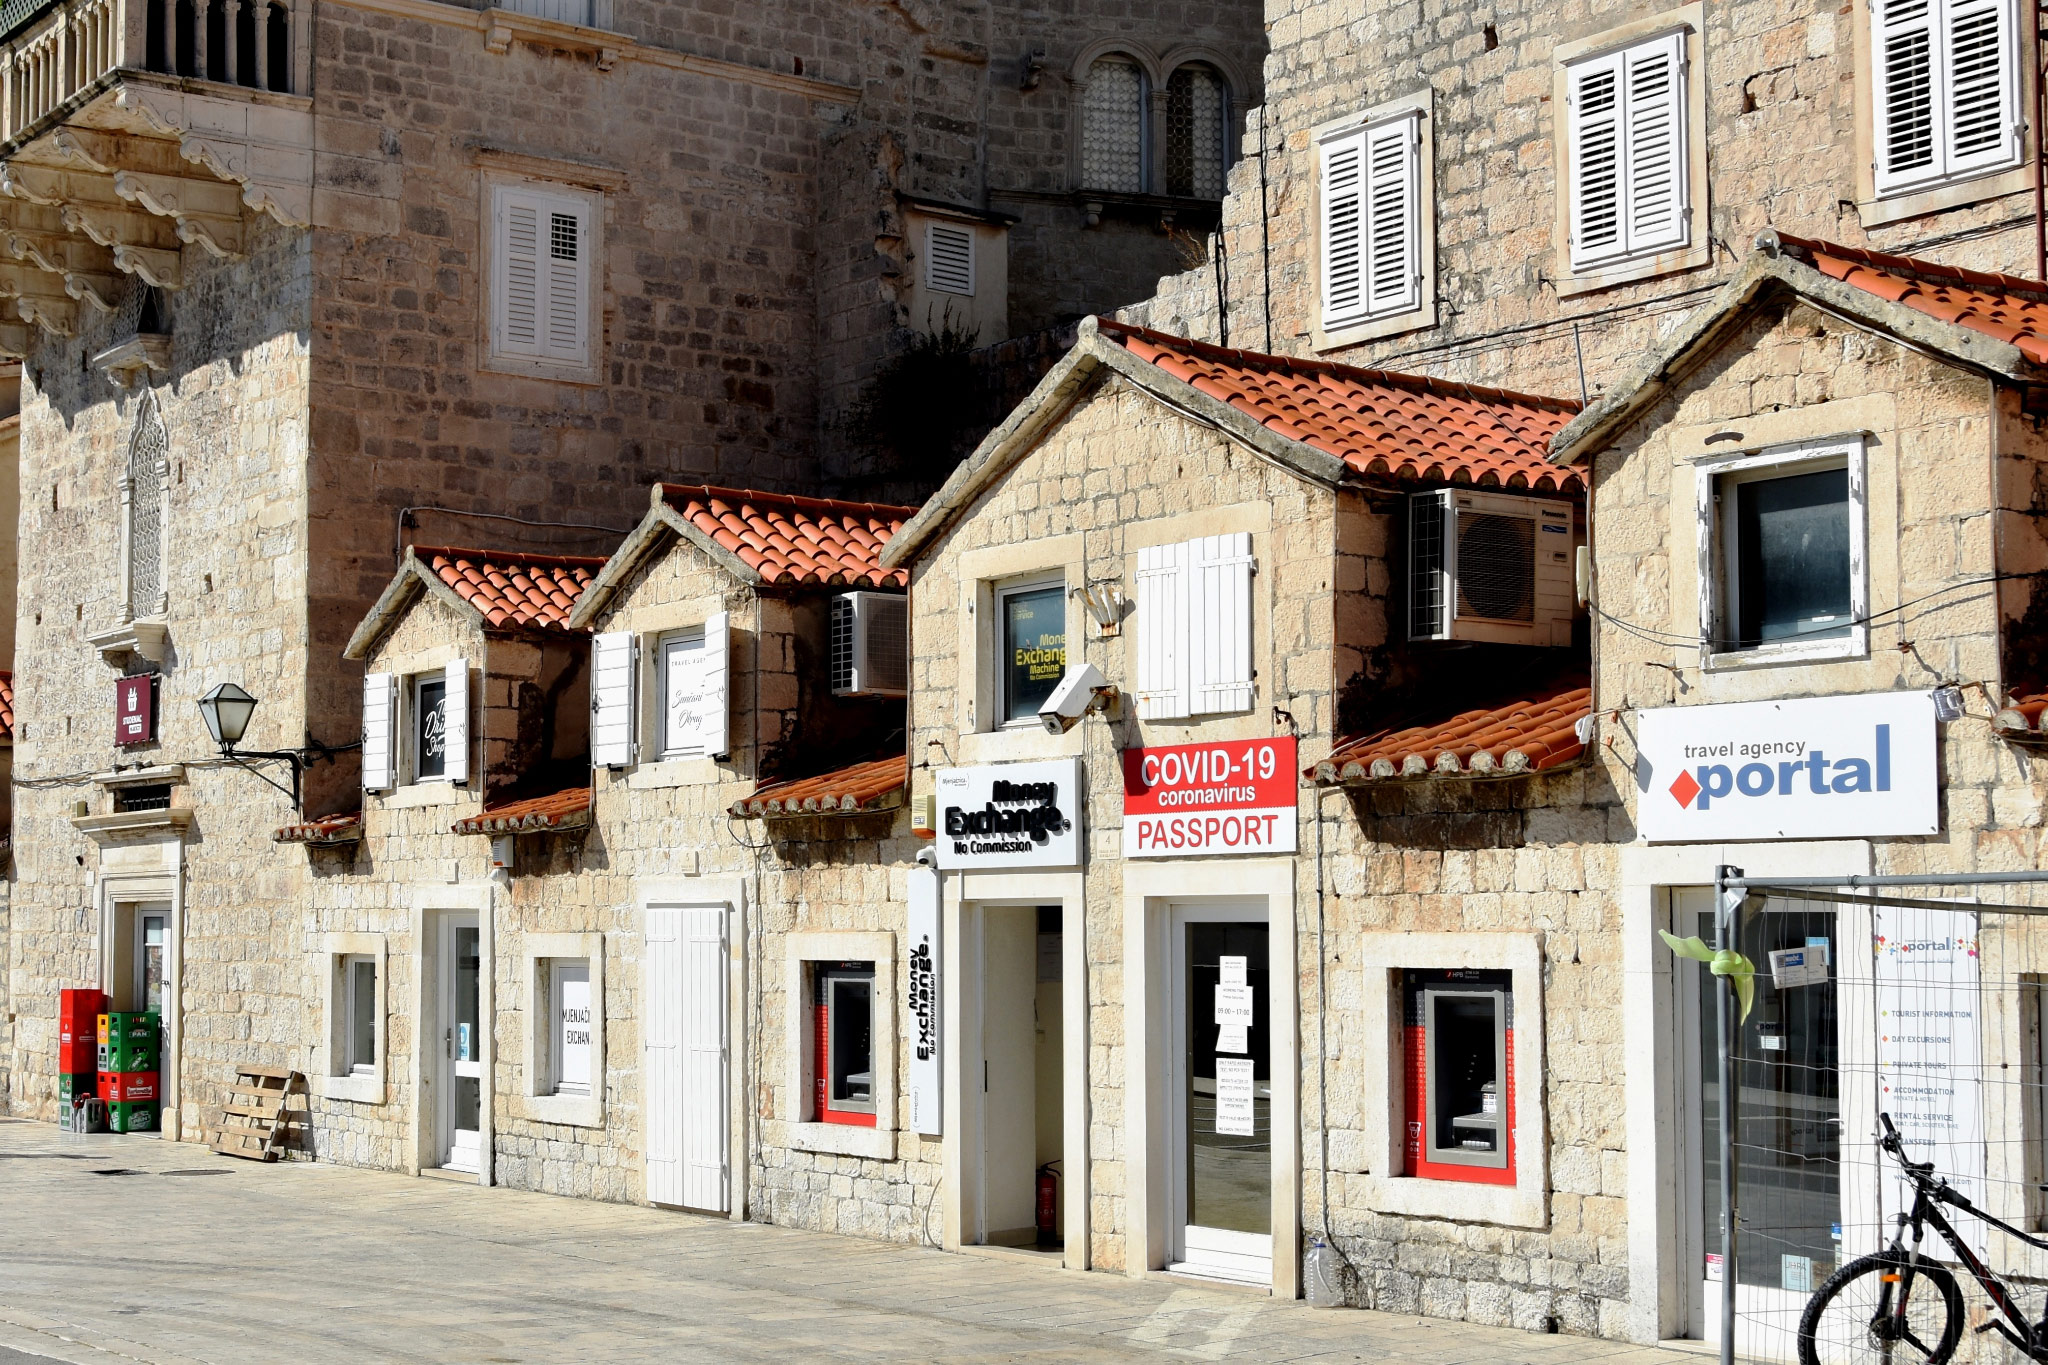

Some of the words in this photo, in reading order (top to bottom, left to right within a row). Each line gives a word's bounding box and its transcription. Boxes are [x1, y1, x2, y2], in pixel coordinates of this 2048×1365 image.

[1040, 633, 1066, 646] Mone
[1016, 646, 1066, 666] Exchang
[1030, 662, 1060, 675] Machine
[425, 711, 446, 739] Dri
[426, 736, 446, 758] Shop
[1684, 741, 1734, 759] travel
[1739, 740, 1806, 759] agency
[1141, 745, 1276, 787] COVID-19
[1696, 723, 1891, 811] portal
[991, 779, 1056, 807] Money
[1158, 782, 1256, 807] coronavirus
[944, 802, 1064, 842] Exchange
[1138, 814, 1279, 850] PASSPORT
[953, 840, 969, 855] No
[970, 836, 1033, 854] Commission
[1908, 936, 1950, 953] portal
[909, 948, 920, 1010] Money
[916, 943, 933, 1061] Exchange
[928, 973, 936, 1038] Commission
[1892, 1010, 1920, 1018] TOURIST
[1922, 1010, 1972, 1019] INFORMATION
[566, 1030, 590, 1045] EXCHAN
[1907, 1036, 1951, 1044] EXCURSIONS
[1892, 1061, 1922, 1069] PRIVATE
[1924, 1061, 1947, 1070] TOURS
[1894, 1087, 1955, 1095] ACCOMMODATION
[1894, 1112, 1922, 1120] RENTAL
[1923, 1113, 1953, 1121] SERVICE
[1899, 1138, 1936, 1146] RANSFERS
